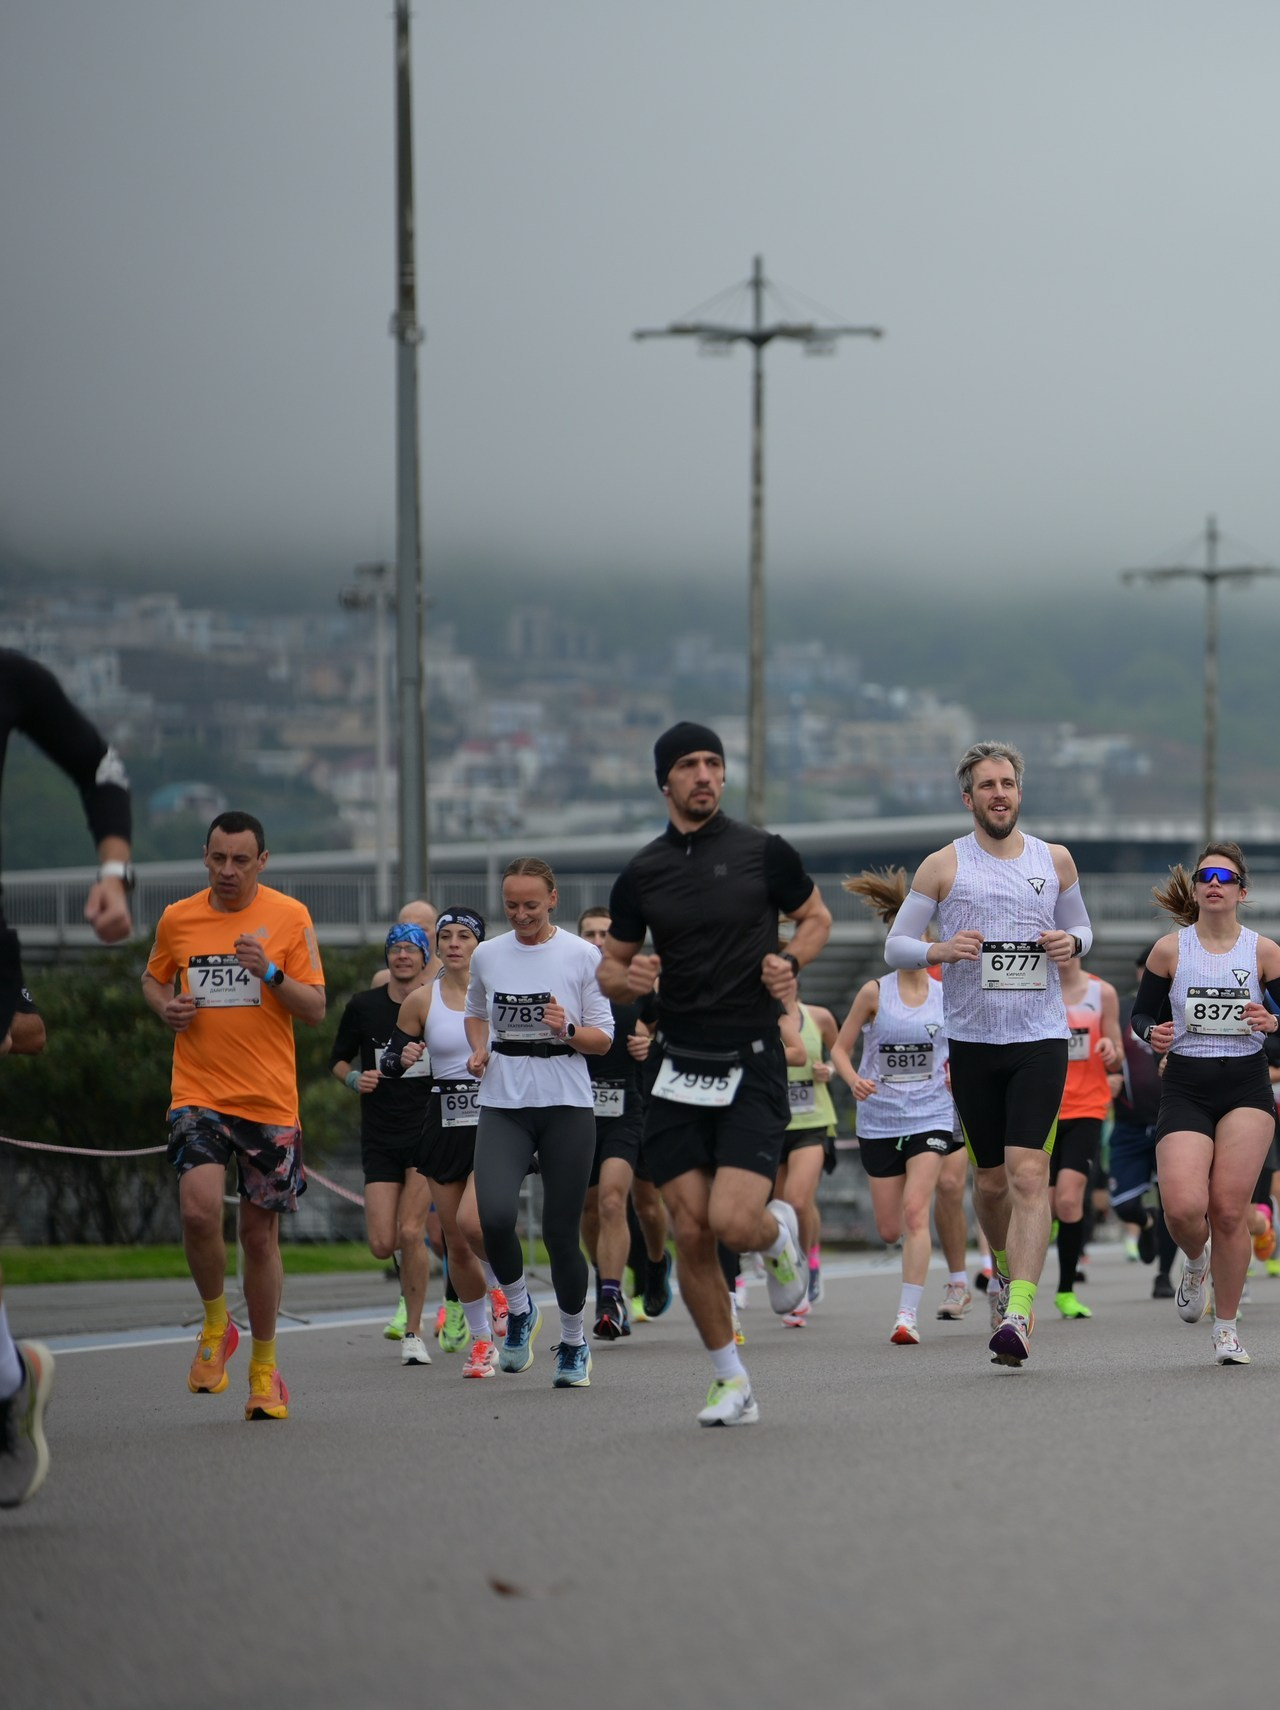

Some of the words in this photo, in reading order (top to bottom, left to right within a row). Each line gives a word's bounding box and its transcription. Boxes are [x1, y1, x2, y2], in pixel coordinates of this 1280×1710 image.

[991, 954, 1041, 971] 6777
[198, 968, 250, 987] 7514
[498, 1005, 545, 1023] 7783
[1193, 1003, 1245, 1021] 8373
[1068, 1036, 1084, 1048] 01
[886, 1053, 927, 1068] 6812
[446, 1093, 480, 1110] 690
[592, 1090, 619, 1103] 54
[790, 1089, 808, 1101] 50
